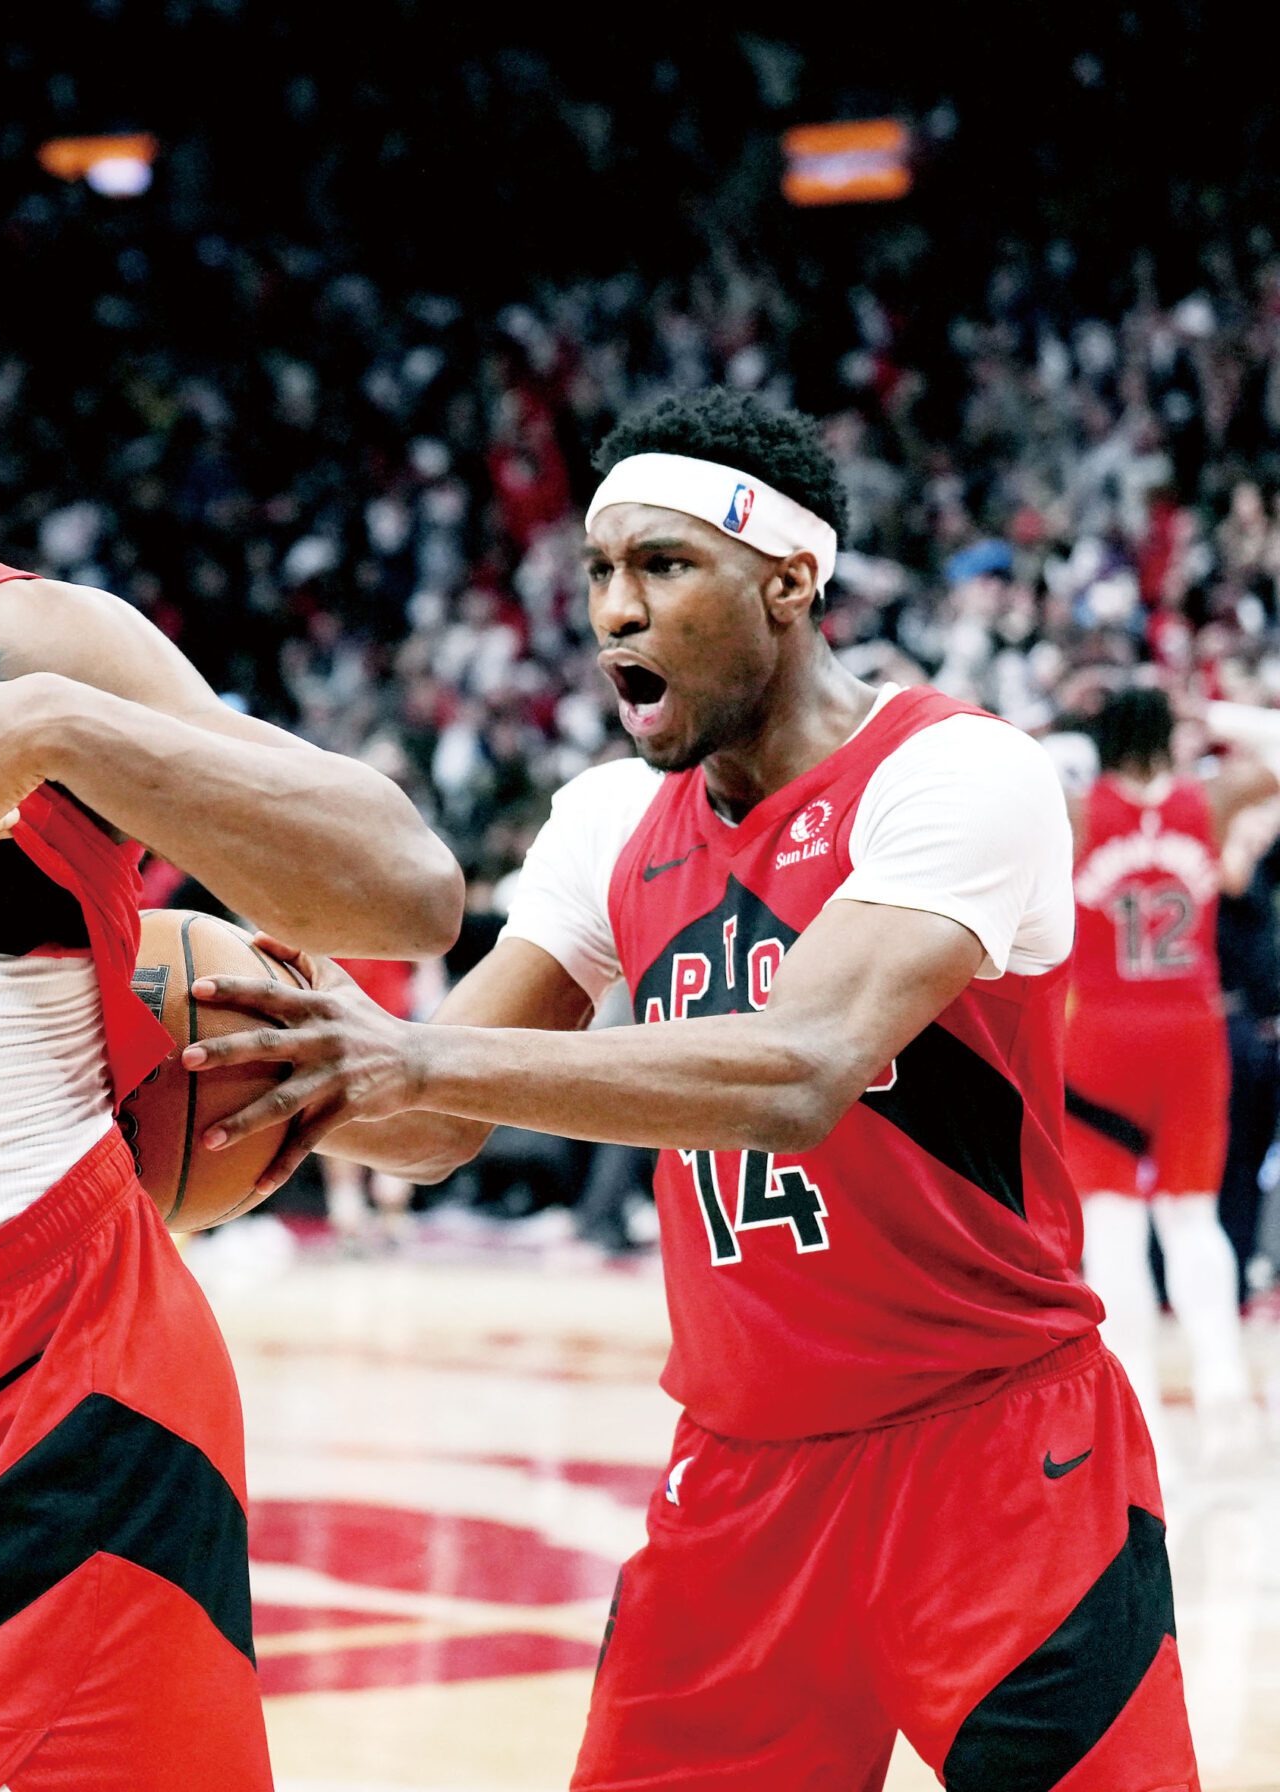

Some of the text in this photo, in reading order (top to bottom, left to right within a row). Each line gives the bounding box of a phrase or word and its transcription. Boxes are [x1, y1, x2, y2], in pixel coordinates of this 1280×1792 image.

[775, 838, 830, 870] Sun Life
[1113, 885, 1198, 979] 12
[678, 1149, 830, 1267] 14
